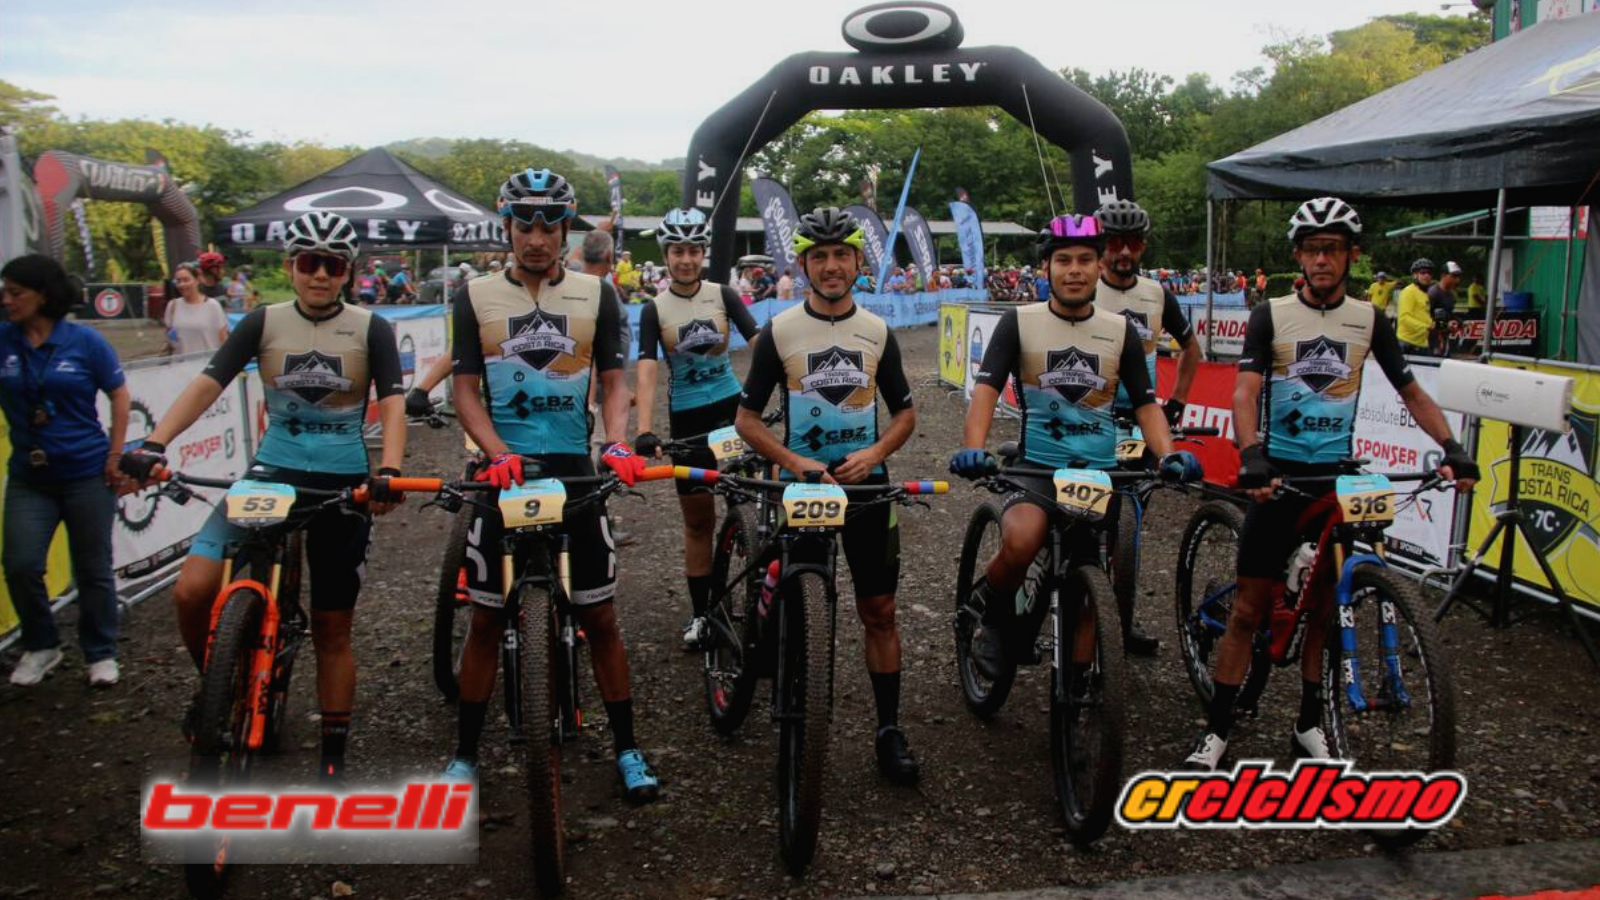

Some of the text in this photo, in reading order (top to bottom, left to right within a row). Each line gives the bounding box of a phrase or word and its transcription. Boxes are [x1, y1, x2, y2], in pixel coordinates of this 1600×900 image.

[809, 63, 981, 85] OAKLEY
[231, 219, 422, 243] OAEY
[512, 341, 565, 352] COSTA RICA
[811, 377, 862, 387] COSTA RICA
[530, 395, 574, 407] CBZ
[1302, 416, 1344, 428] CBZ
[1360, 401, 1417, 428] absoluteBL
[825, 426, 867, 440] CBZ
[180, 434, 221, 467] SPONSER
[1355, 438, 1417, 467] SPONSER
[1530, 463, 1571, 485] TRANS
[1060, 483, 1106, 506] 407
[1518, 478, 1590, 517] OSTA RICA
[243, 497, 277, 512] 53
[523, 499, 541, 518] 9
[792, 500, 841, 519] 209
[1349, 496, 1388, 515] 316
